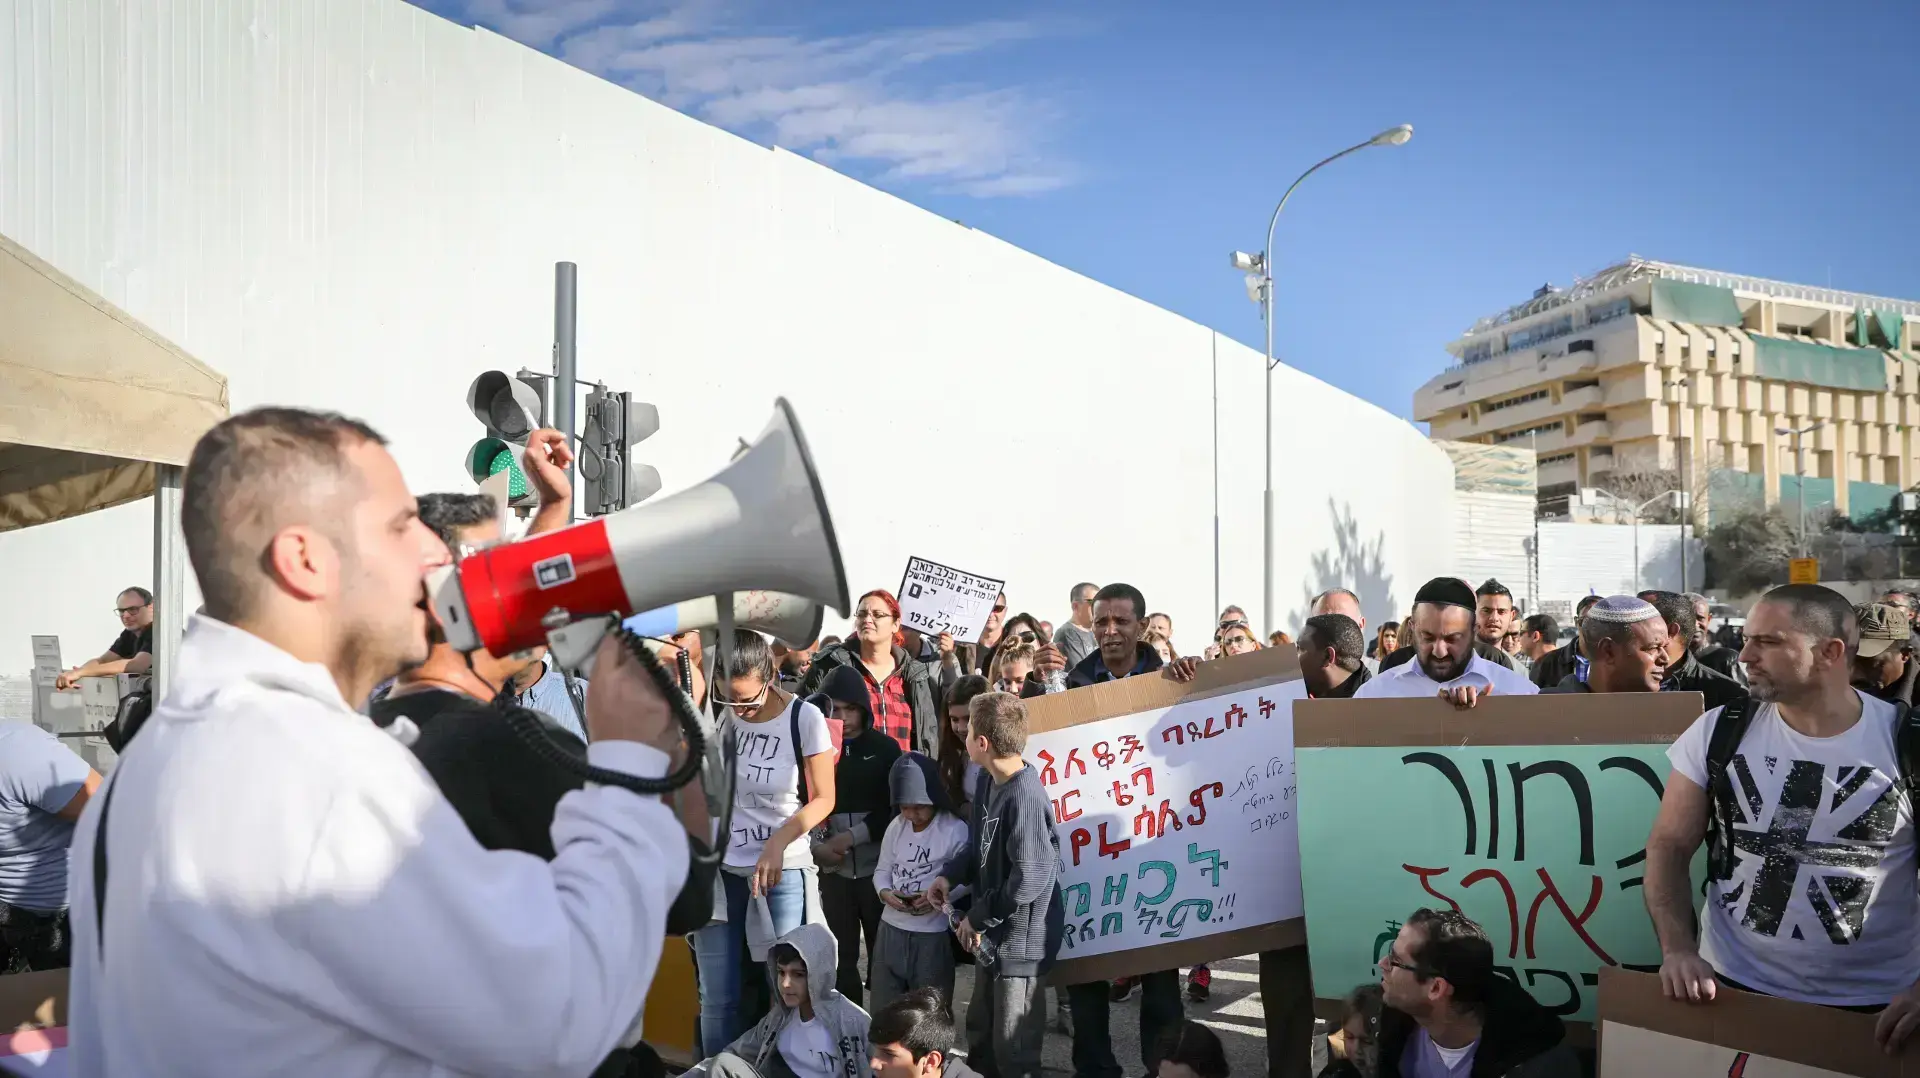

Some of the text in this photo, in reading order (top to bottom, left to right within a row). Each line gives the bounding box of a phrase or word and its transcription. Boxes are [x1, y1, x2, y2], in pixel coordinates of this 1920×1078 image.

[912, 559, 996, 591] בצער רב ובלב כואב
[946, 580, 955, 590] על
[956, 585, 986, 599] מודיעים
[907, 842, 931, 864] אני
